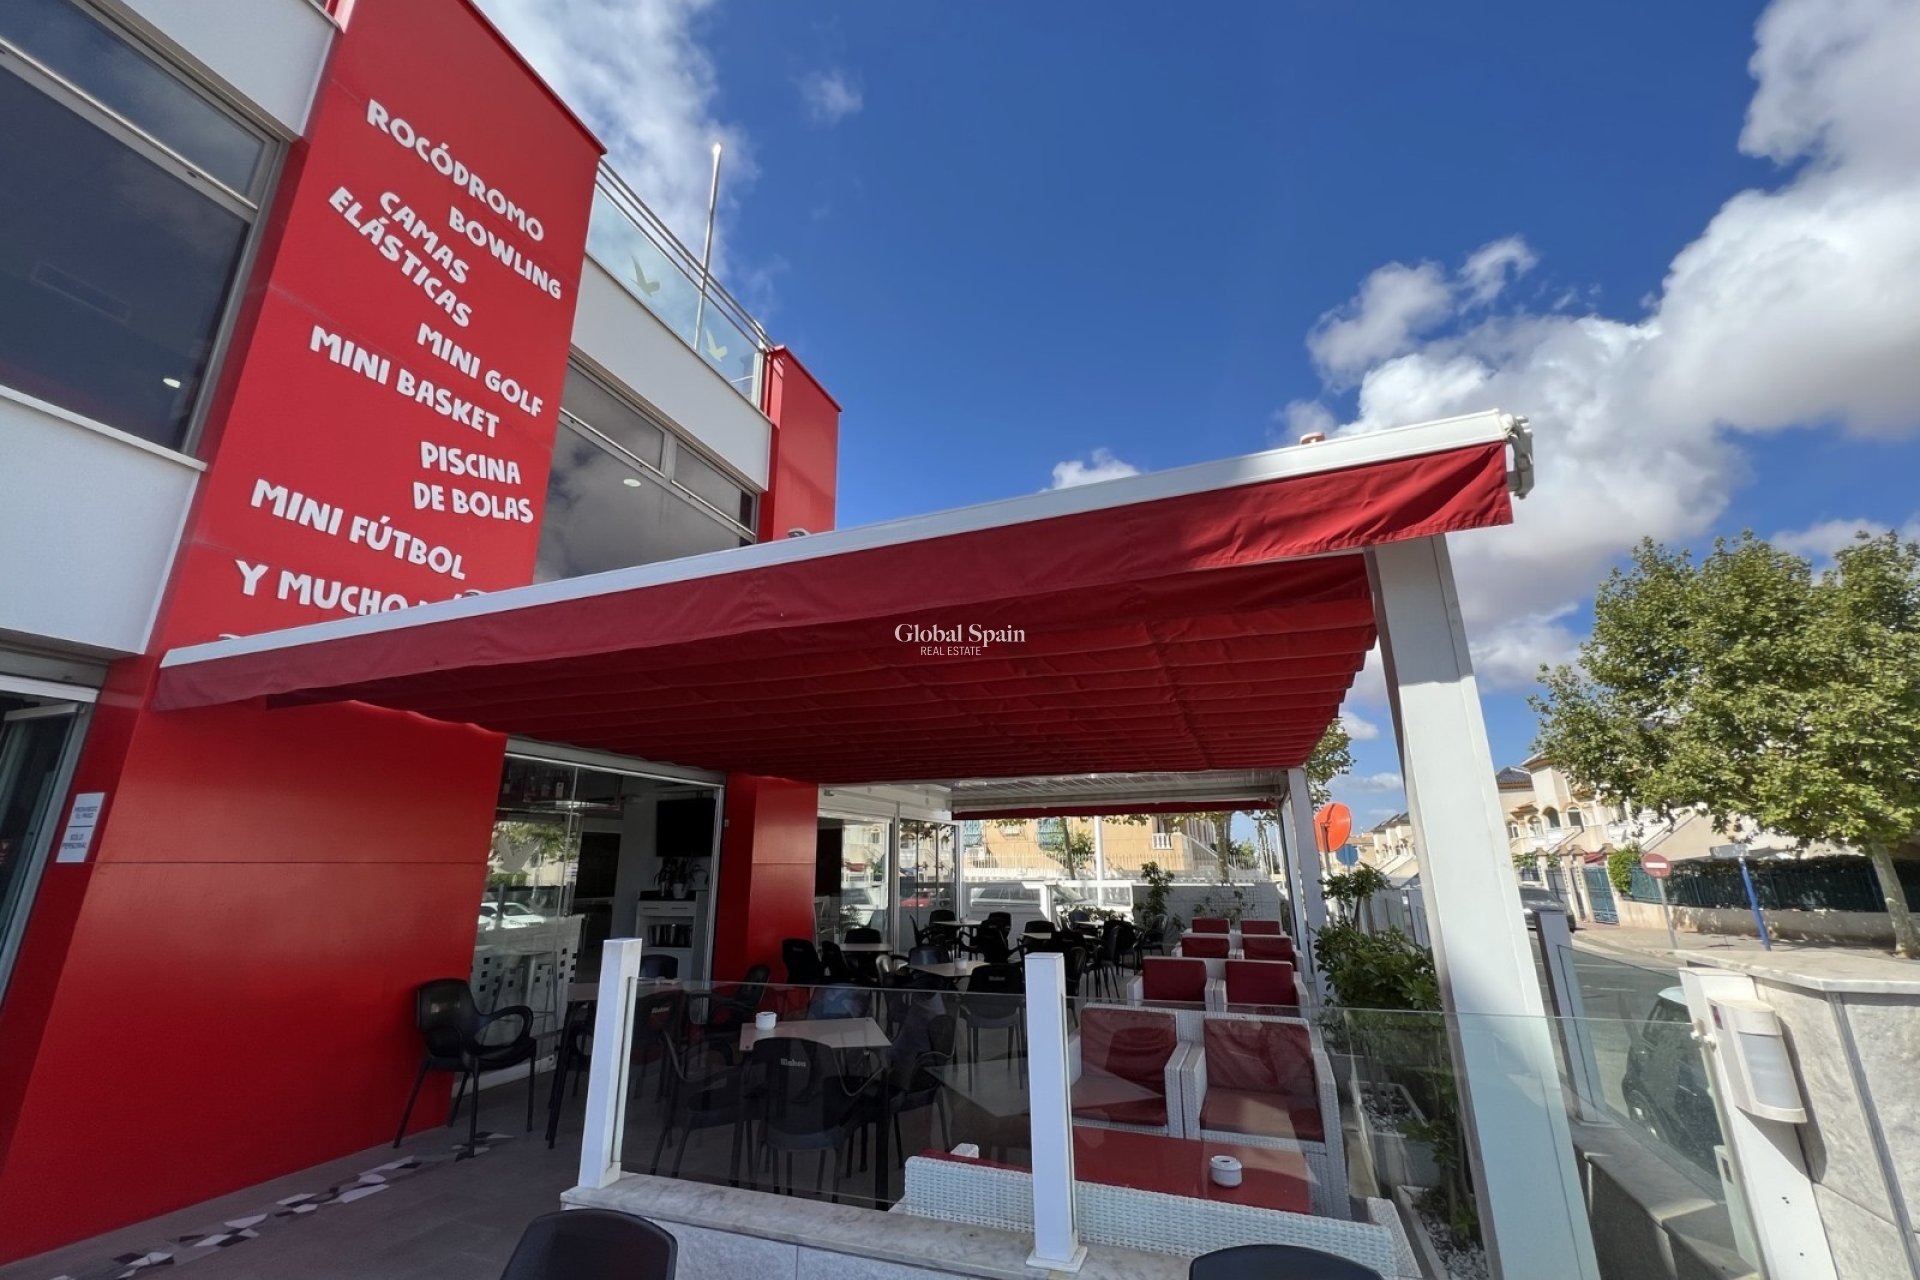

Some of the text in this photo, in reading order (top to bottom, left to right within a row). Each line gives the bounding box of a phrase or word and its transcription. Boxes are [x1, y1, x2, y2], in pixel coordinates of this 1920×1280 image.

[367, 98, 545, 242] ROCÓDROMO
[328, 186, 473, 328] ELÁSTICAS
[379, 191, 470, 284] CAMAS
[449, 206, 562, 300] BOWLING
[310, 325, 500, 438] MINI BASKET
[416, 322, 543, 417] MINI GOLF
[413, 481, 534, 524] DE BOLAS
[420, 441, 522, 485] PISCINA
[250, 478, 466, 581] MINI FÚTBOL
[235, 559, 269, 596] Y
[277, 570, 409, 616] MUCHO
